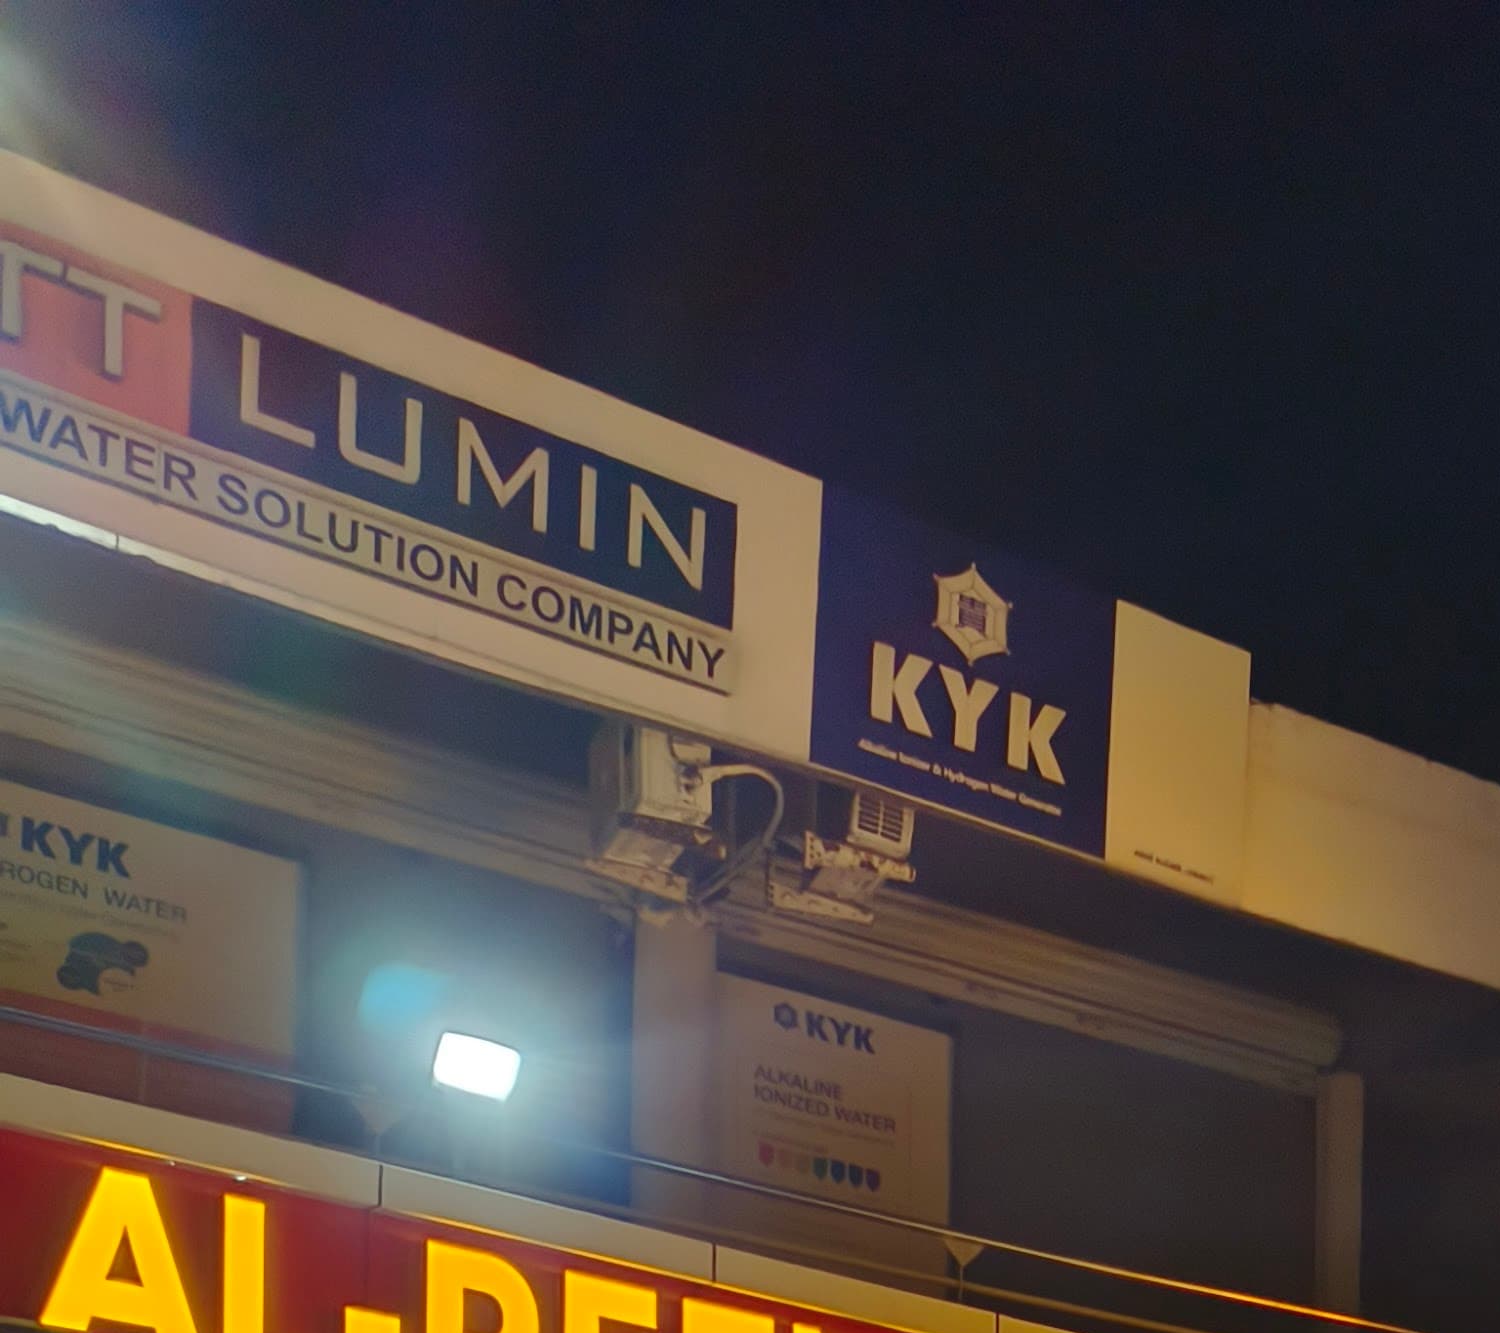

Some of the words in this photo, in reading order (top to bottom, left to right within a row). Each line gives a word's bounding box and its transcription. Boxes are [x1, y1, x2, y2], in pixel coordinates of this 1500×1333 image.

[239, 333, 706, 592] LUMIN
[0, 391, 197, 500] WATER
[216, 473, 481, 598] SOLUTION
[496, 573, 726, 681] COMPANY
[870, 641, 1066, 785] KYK
[20, 816, 131, 879] KYK
[104, 886, 187, 924] WATER
[805, 1010, 875, 1054] KYK
[754, 1065, 842, 1100] ALKALINE
[754, 1084, 830, 1118] IONIZED
[834, 1106, 897, 1134] WATER
